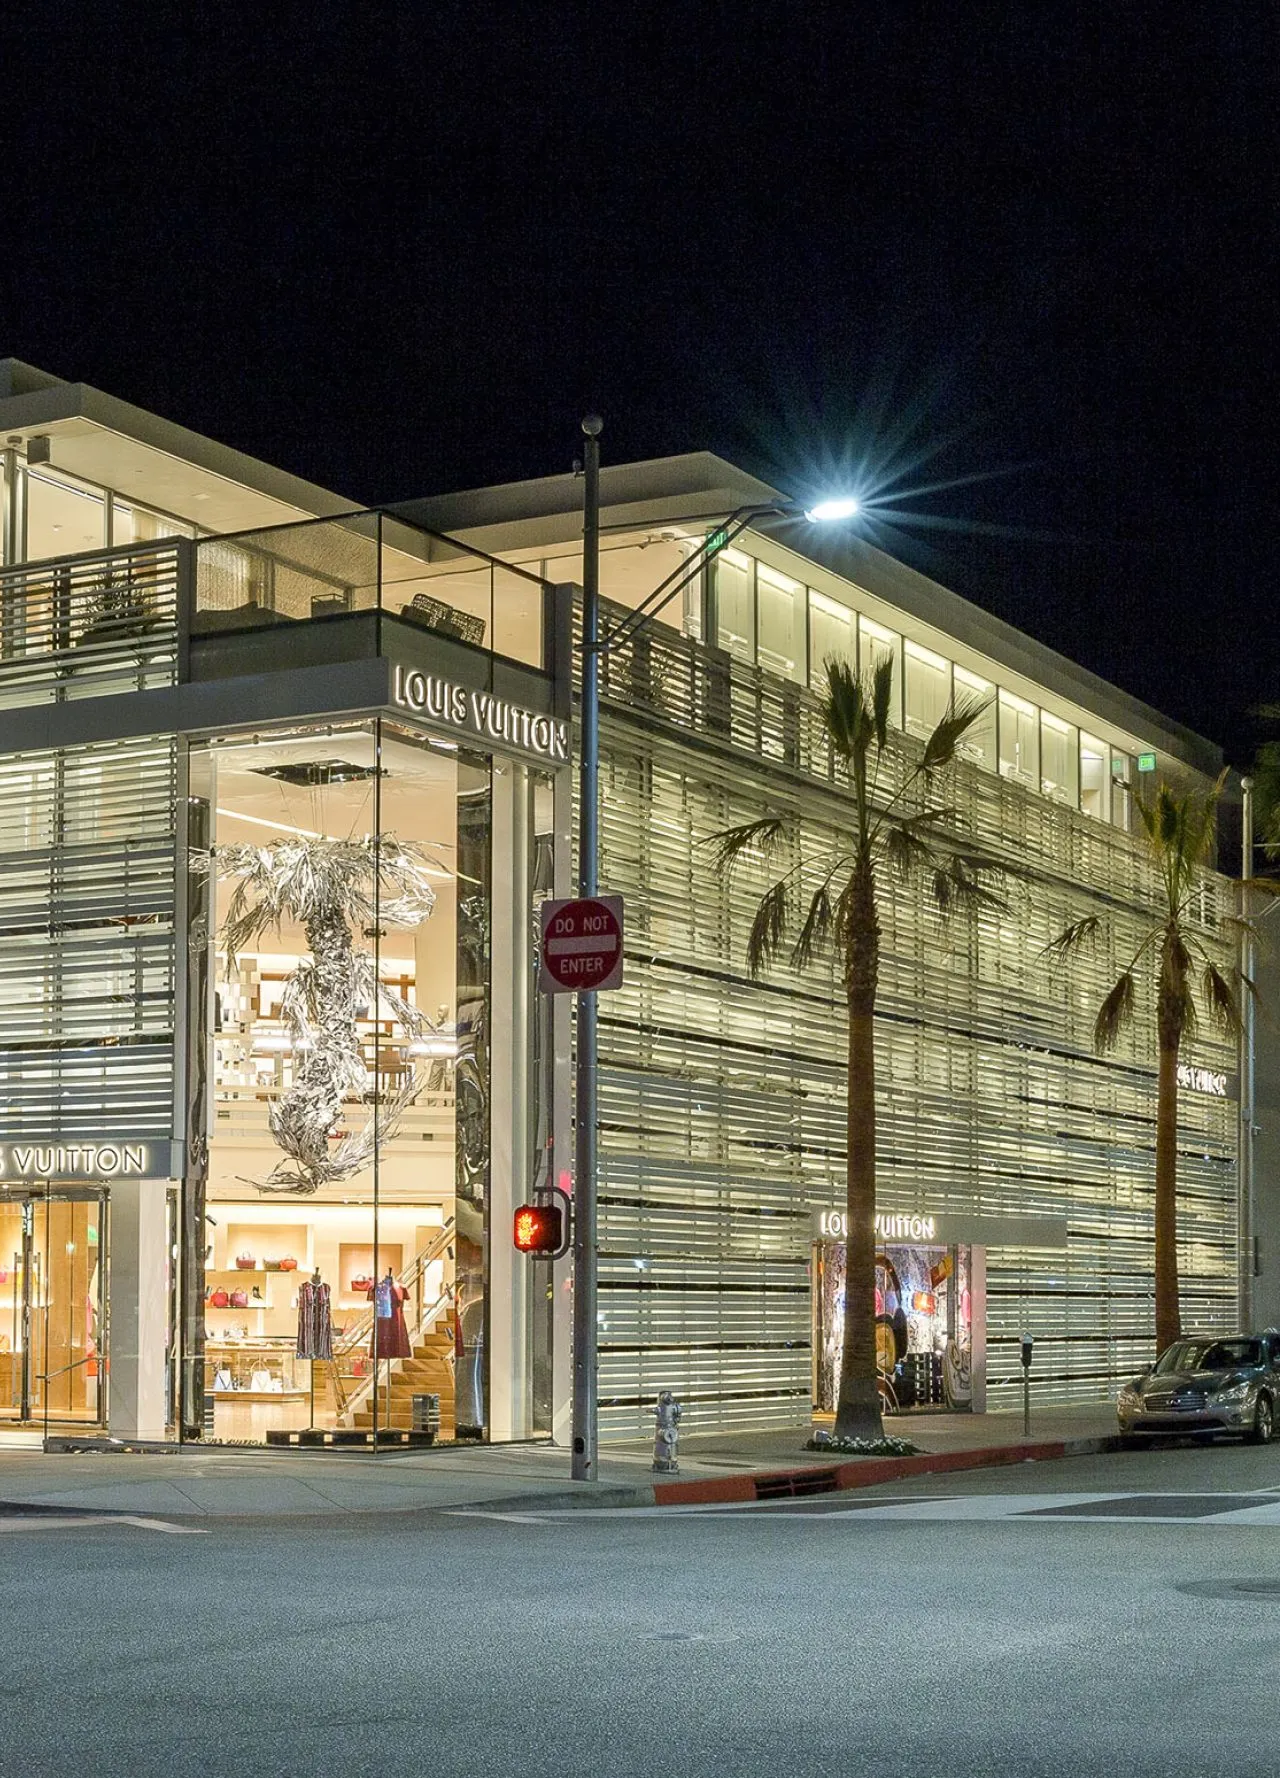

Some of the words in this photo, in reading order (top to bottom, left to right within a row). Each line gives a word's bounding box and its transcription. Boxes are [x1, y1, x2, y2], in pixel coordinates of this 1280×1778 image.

[394, 665, 467, 724] LOUIS
[471, 692, 569, 759] VUITTON
[555, 918, 575, 934] DO
[583, 915, 609, 932] NOT
[560, 957, 604, 974] ENTER
[13, 1145, 146, 1174] VUITTON
